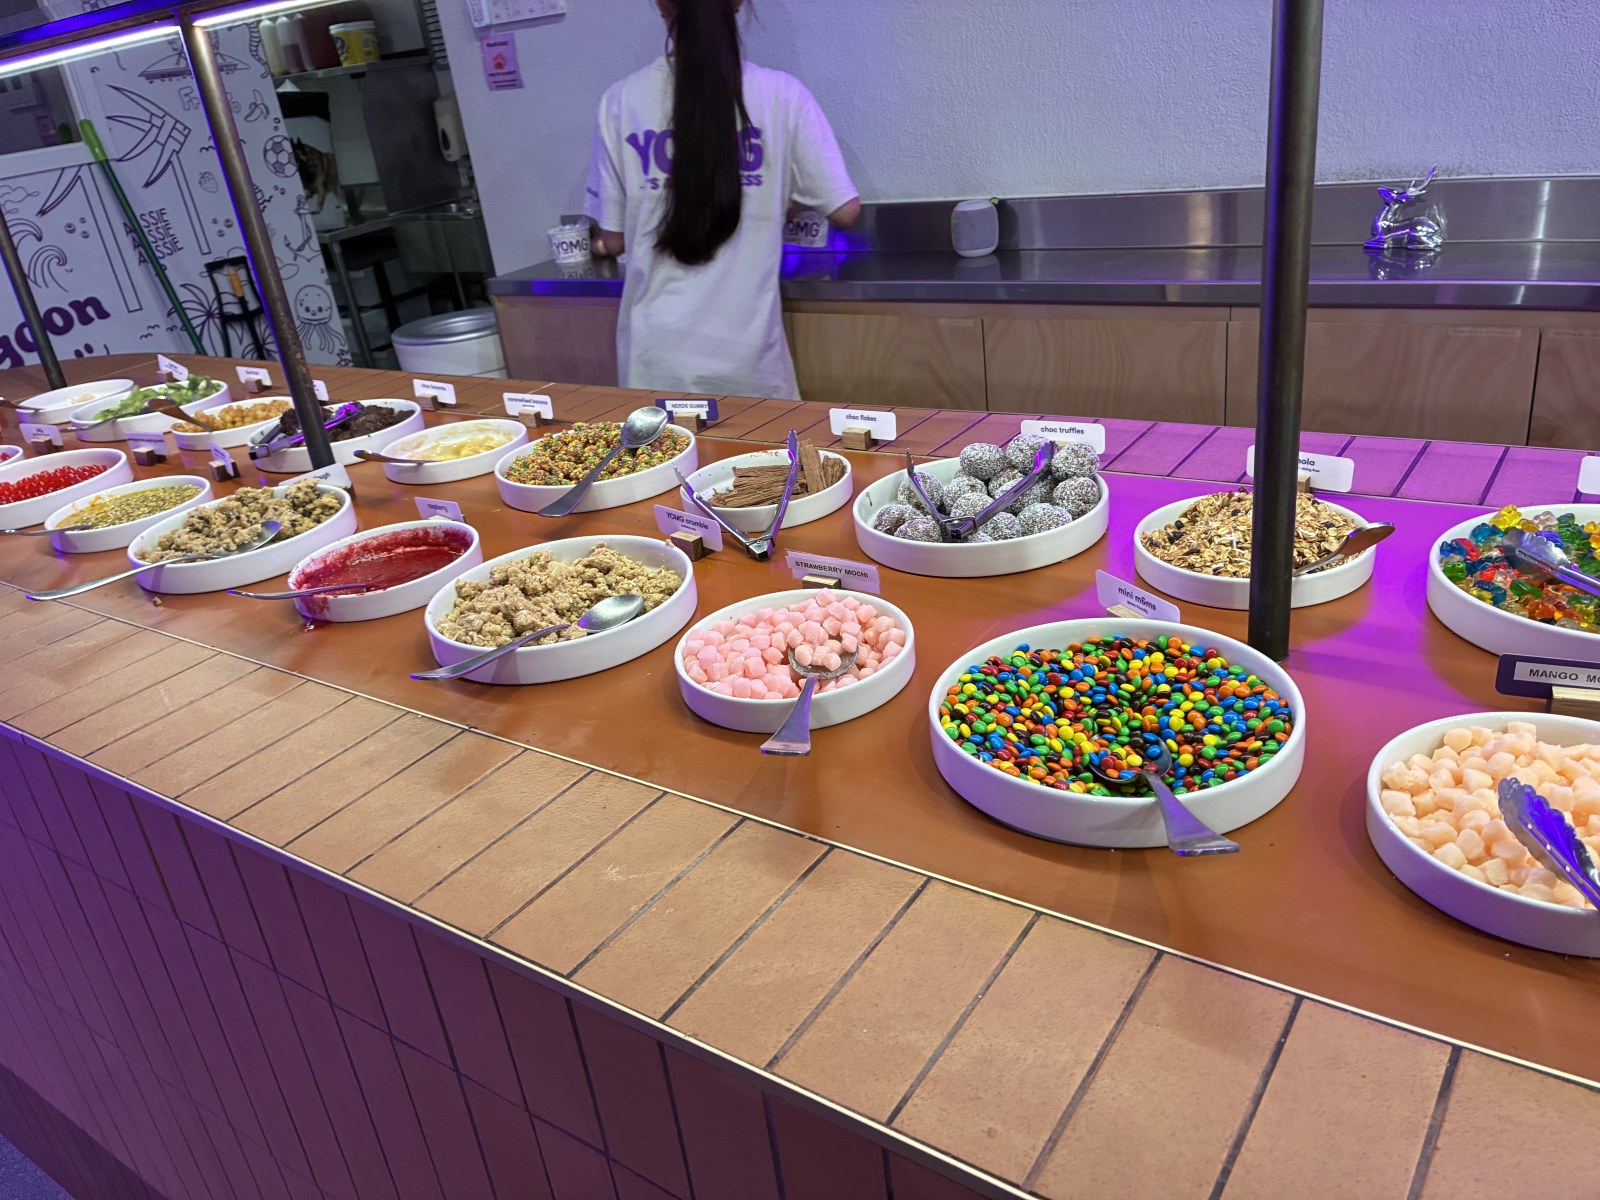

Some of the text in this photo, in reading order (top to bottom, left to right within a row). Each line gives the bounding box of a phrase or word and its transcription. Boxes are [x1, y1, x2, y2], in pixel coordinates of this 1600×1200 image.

[625, 126, 764, 176] YOG
[123, 208, 169, 237] ASSIE
[785, 220, 821, 238] OMG
[132, 223, 176, 251] ASSIE
[553, 237, 590, 256] YOMG
[139, 237, 184, 266] ASSIE
[845, 413, 877, 422] choc flakes
[665, 511, 685, 523] YOMG
[685, 518, 709, 530] crumble
[794, 560, 869, 579] STRAWBERRY MOCHI
[1118, 587, 1134, 600] mini
[1528, 668, 1579, 681] MANGO
